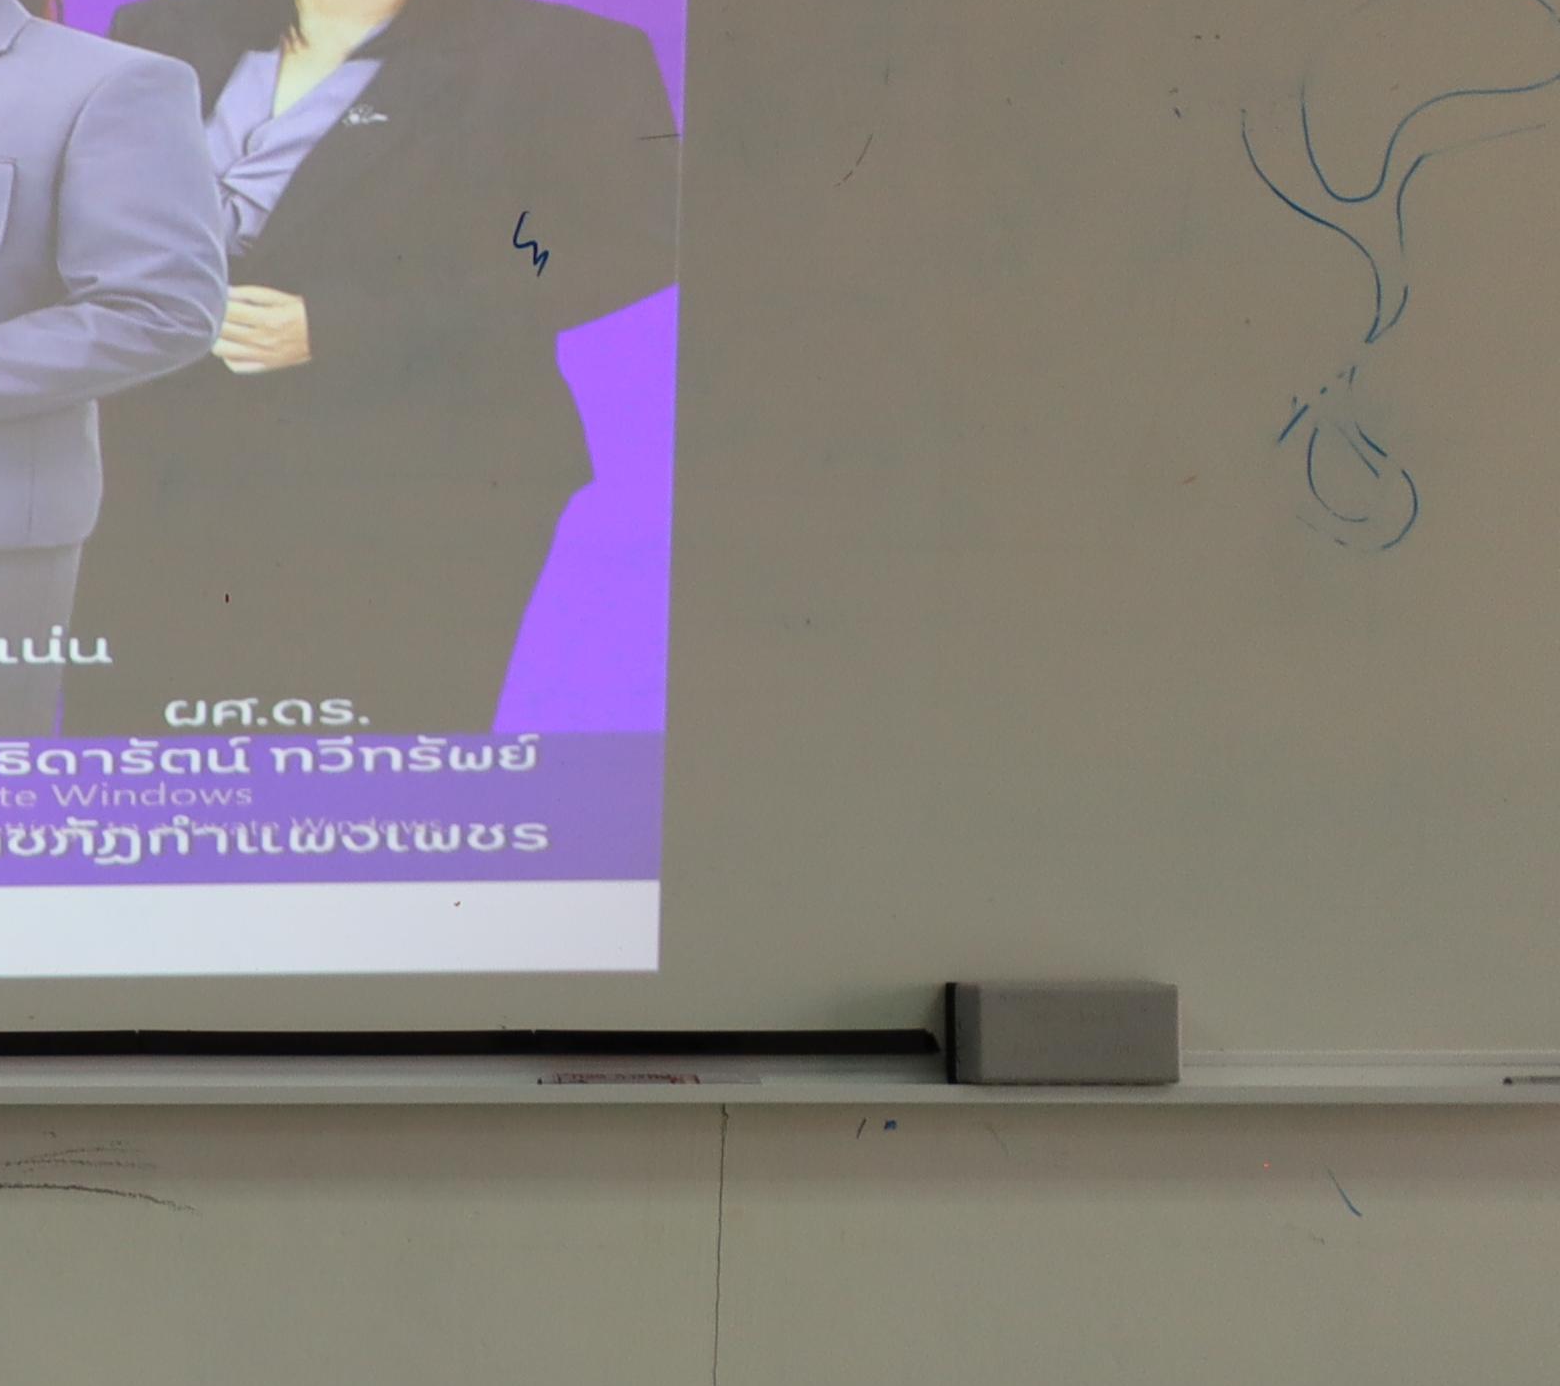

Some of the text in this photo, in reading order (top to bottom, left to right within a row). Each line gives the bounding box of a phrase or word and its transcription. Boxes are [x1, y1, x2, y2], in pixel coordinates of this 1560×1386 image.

[165, 697, 371, 726] ผศ.ดร.
[270, 734, 540, 774] ทวีทรัพย์
[51, 781, 253, 807] Windows
